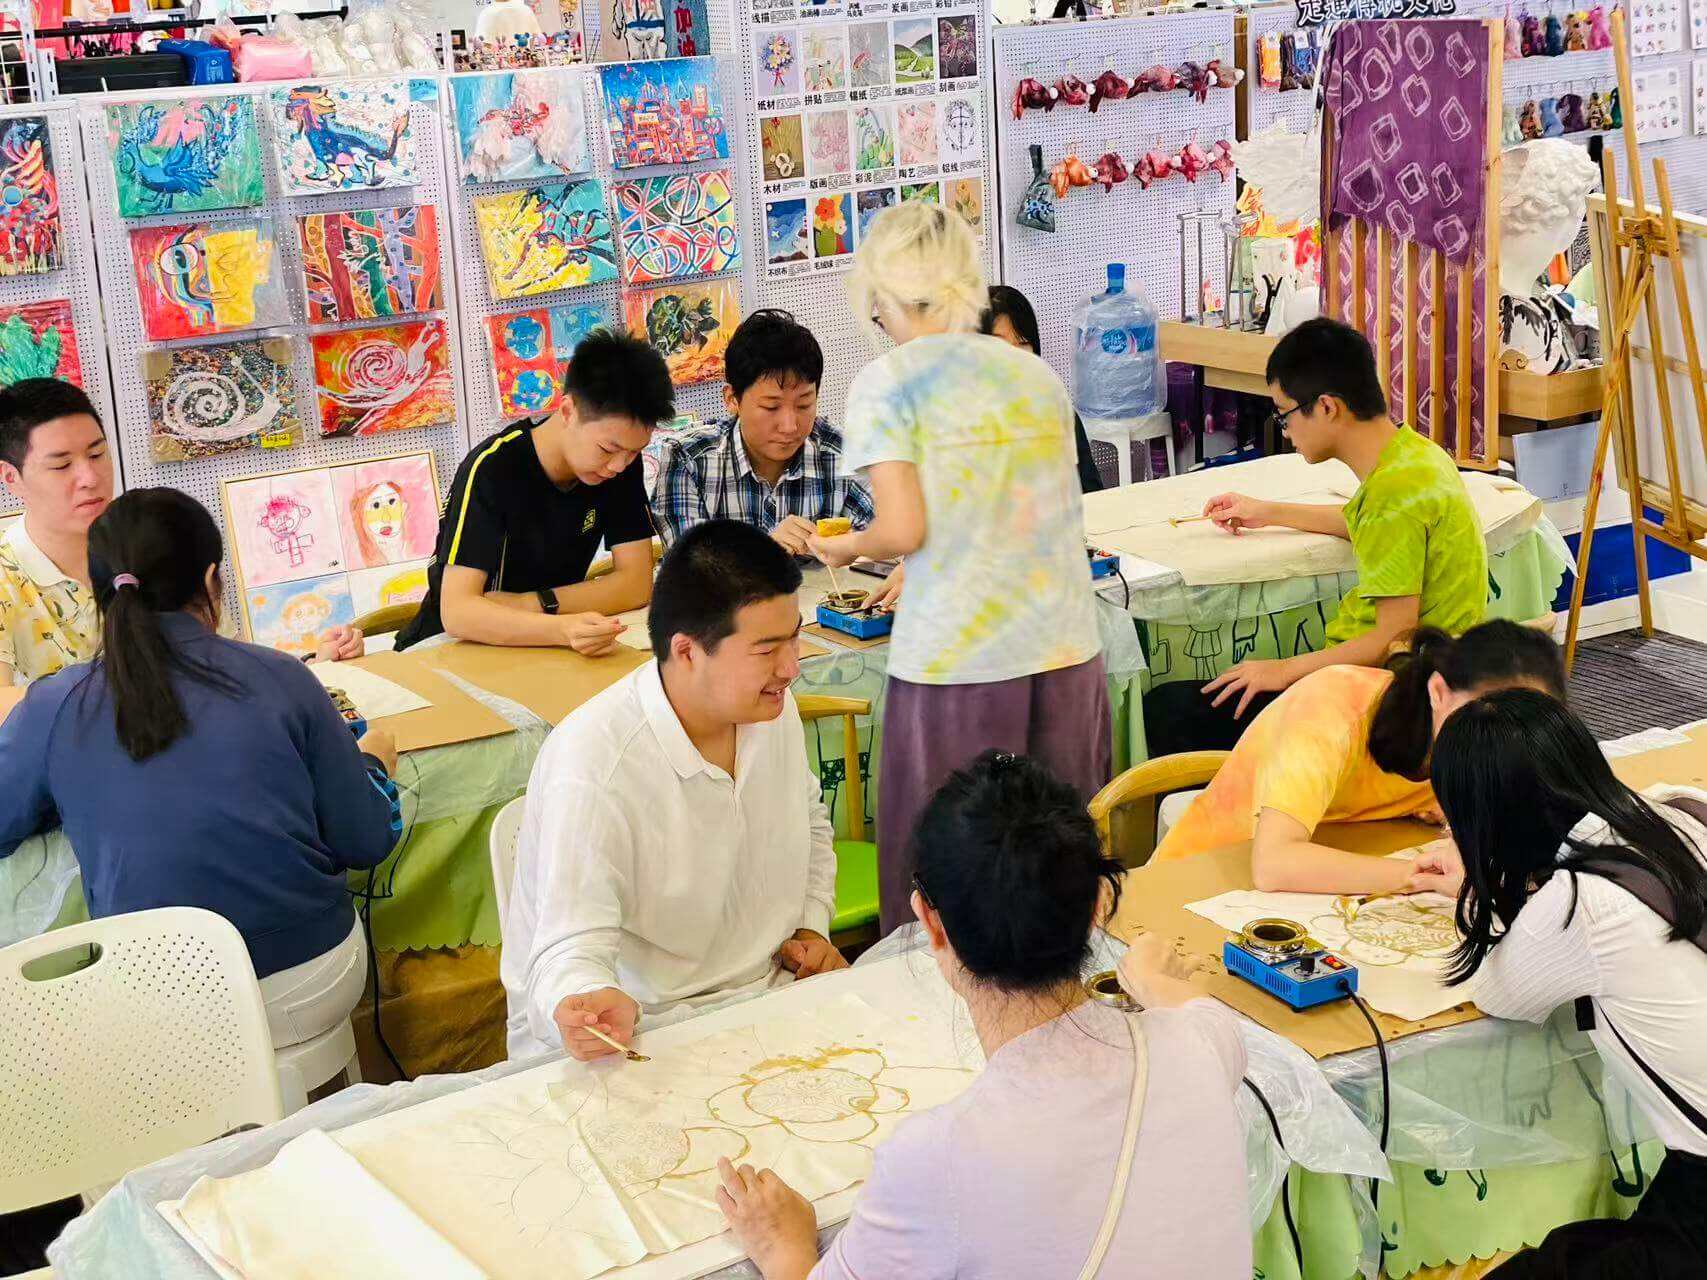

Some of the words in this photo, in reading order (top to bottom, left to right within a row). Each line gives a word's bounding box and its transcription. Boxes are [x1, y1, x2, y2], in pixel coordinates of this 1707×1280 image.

[804, 94, 822, 105] 拼贴
[899, 168, 916, 178] 陶艺
[810, 178, 827, 189] 版画
[763, 184, 781, 195] 木材
